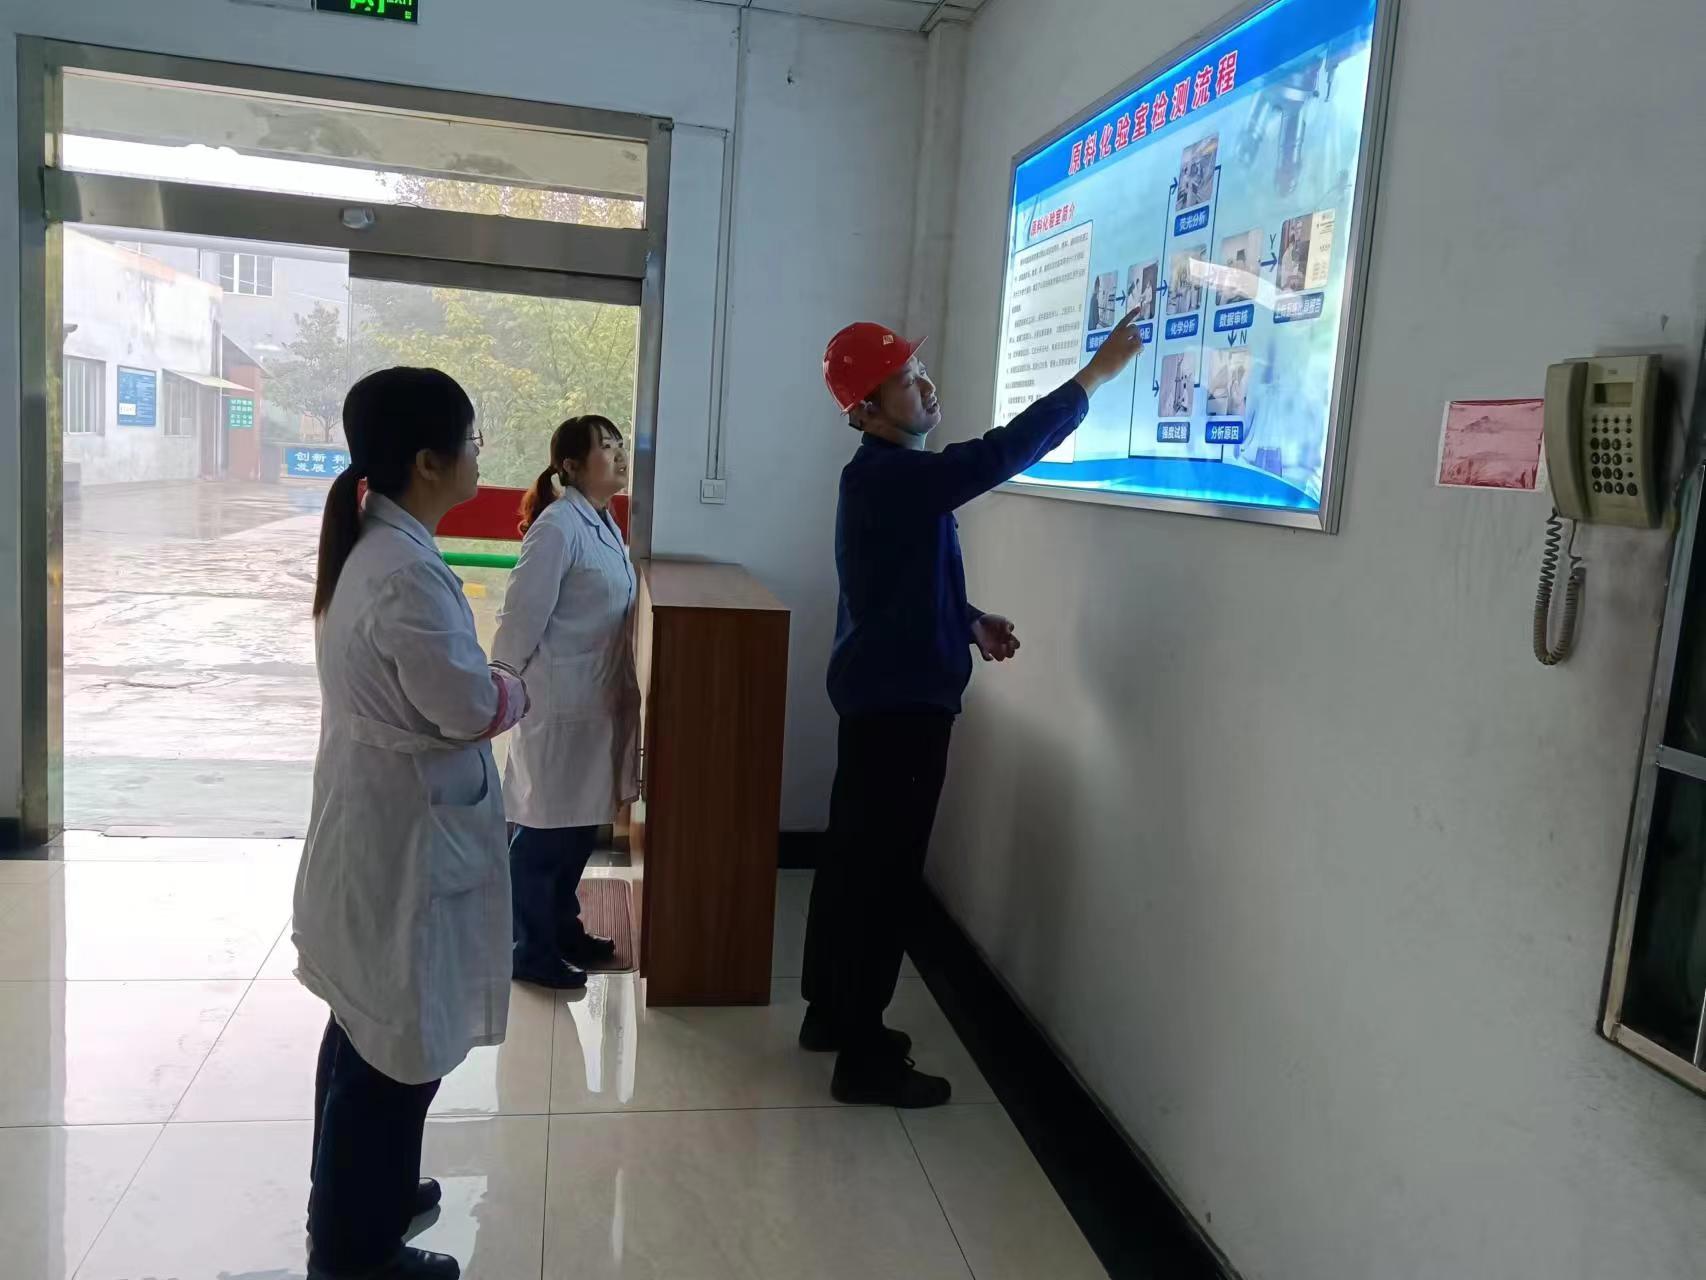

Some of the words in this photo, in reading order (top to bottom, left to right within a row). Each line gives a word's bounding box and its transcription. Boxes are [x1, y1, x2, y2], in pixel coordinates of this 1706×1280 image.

[1069, 50, 1238, 176] 原料化验室检测流程
[1031, 202, 1075, 237] 原料化验室简介
[1179, 210, 1206, 231] 荧光分析
[1269, 233, 1277, 249] Y
[1170, 319, 1196, 335] 化学分析
[1219, 309, 1248, 328] 数据审核
[1240, 330, 1248, 344] N
[1211, 425, 1239, 440] 分析原因
